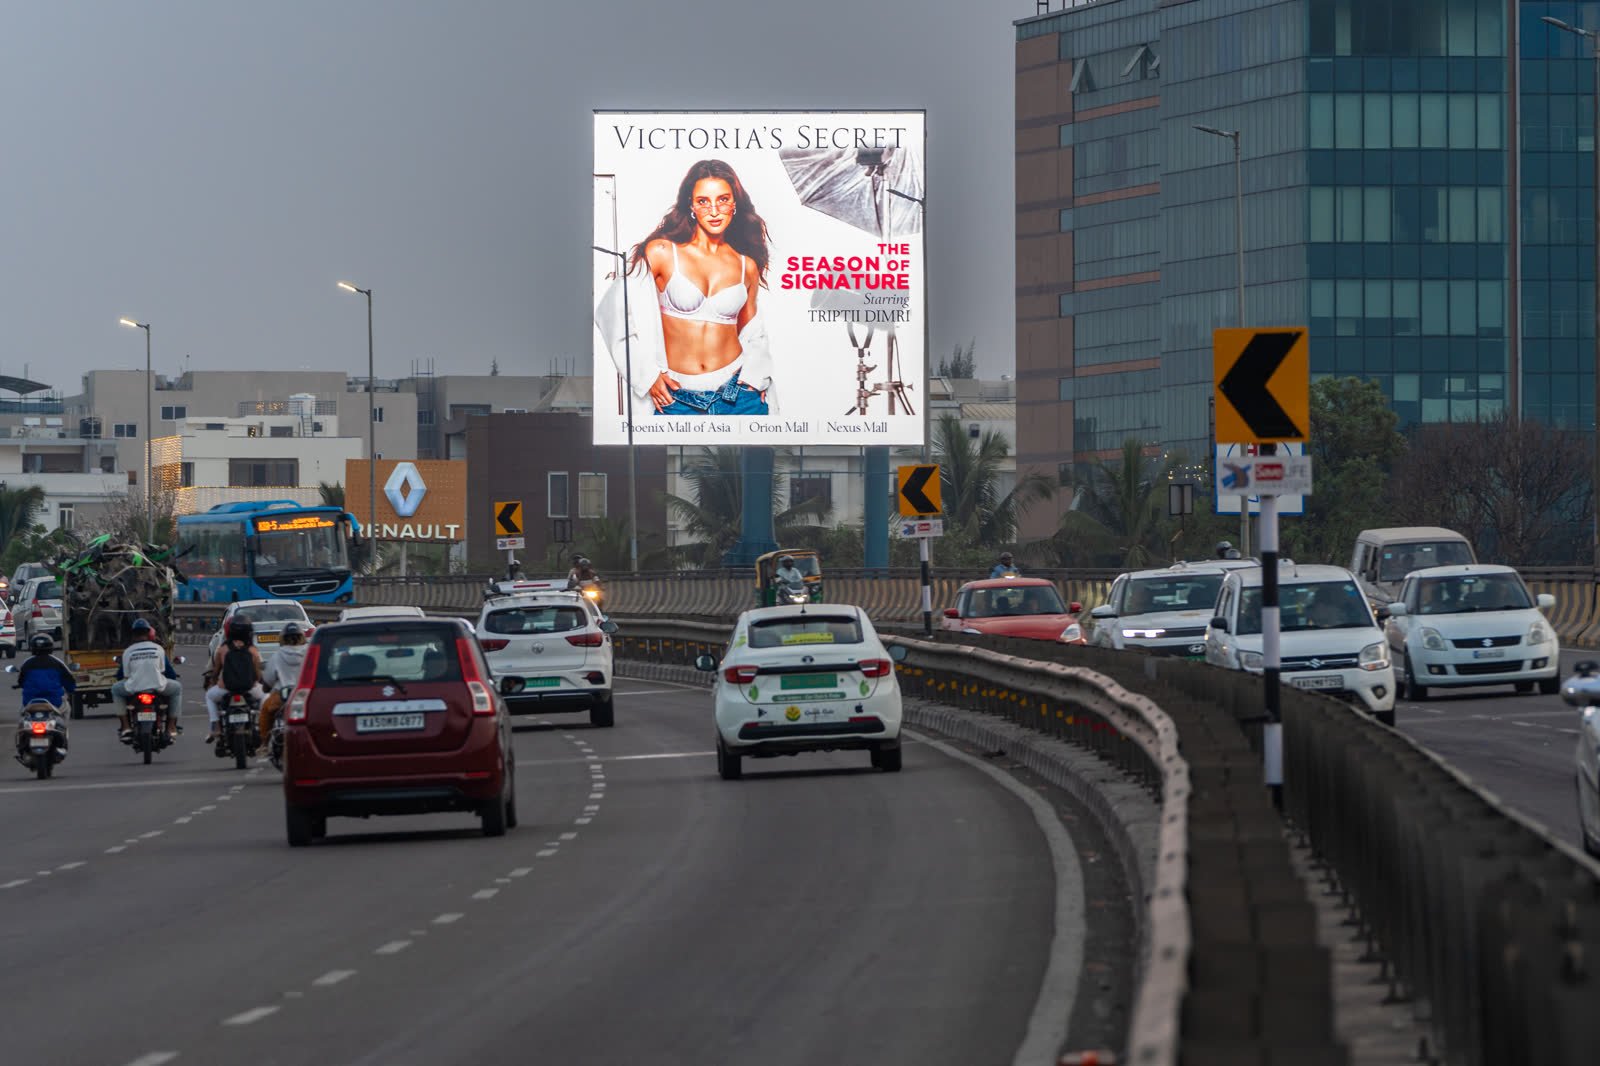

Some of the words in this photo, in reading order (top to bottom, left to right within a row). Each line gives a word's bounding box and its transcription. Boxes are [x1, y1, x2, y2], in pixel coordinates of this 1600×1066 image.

[797, 125, 906, 149] SECRET
[877, 243, 910, 255] THE
[787, 256, 880, 272] SEASON
[887, 259, 910, 271] OF
[781, 273, 910, 290] SIGNATURE
[863, 292, 910, 309] Starring
[808, 309, 860, 322] TRIPTII
[865, 309, 910, 322] DIMRI
[667, 421, 691, 433] Mall
[693, 421, 706, 433] of
[707, 421, 731, 433] Asia
[749, 421, 782, 433] Orion
[785, 421, 808, 433] Mall
[827, 421, 861, 433] Nexus
[863, 421, 887, 433] Mall
[350, 523, 460, 539] RENAULT
